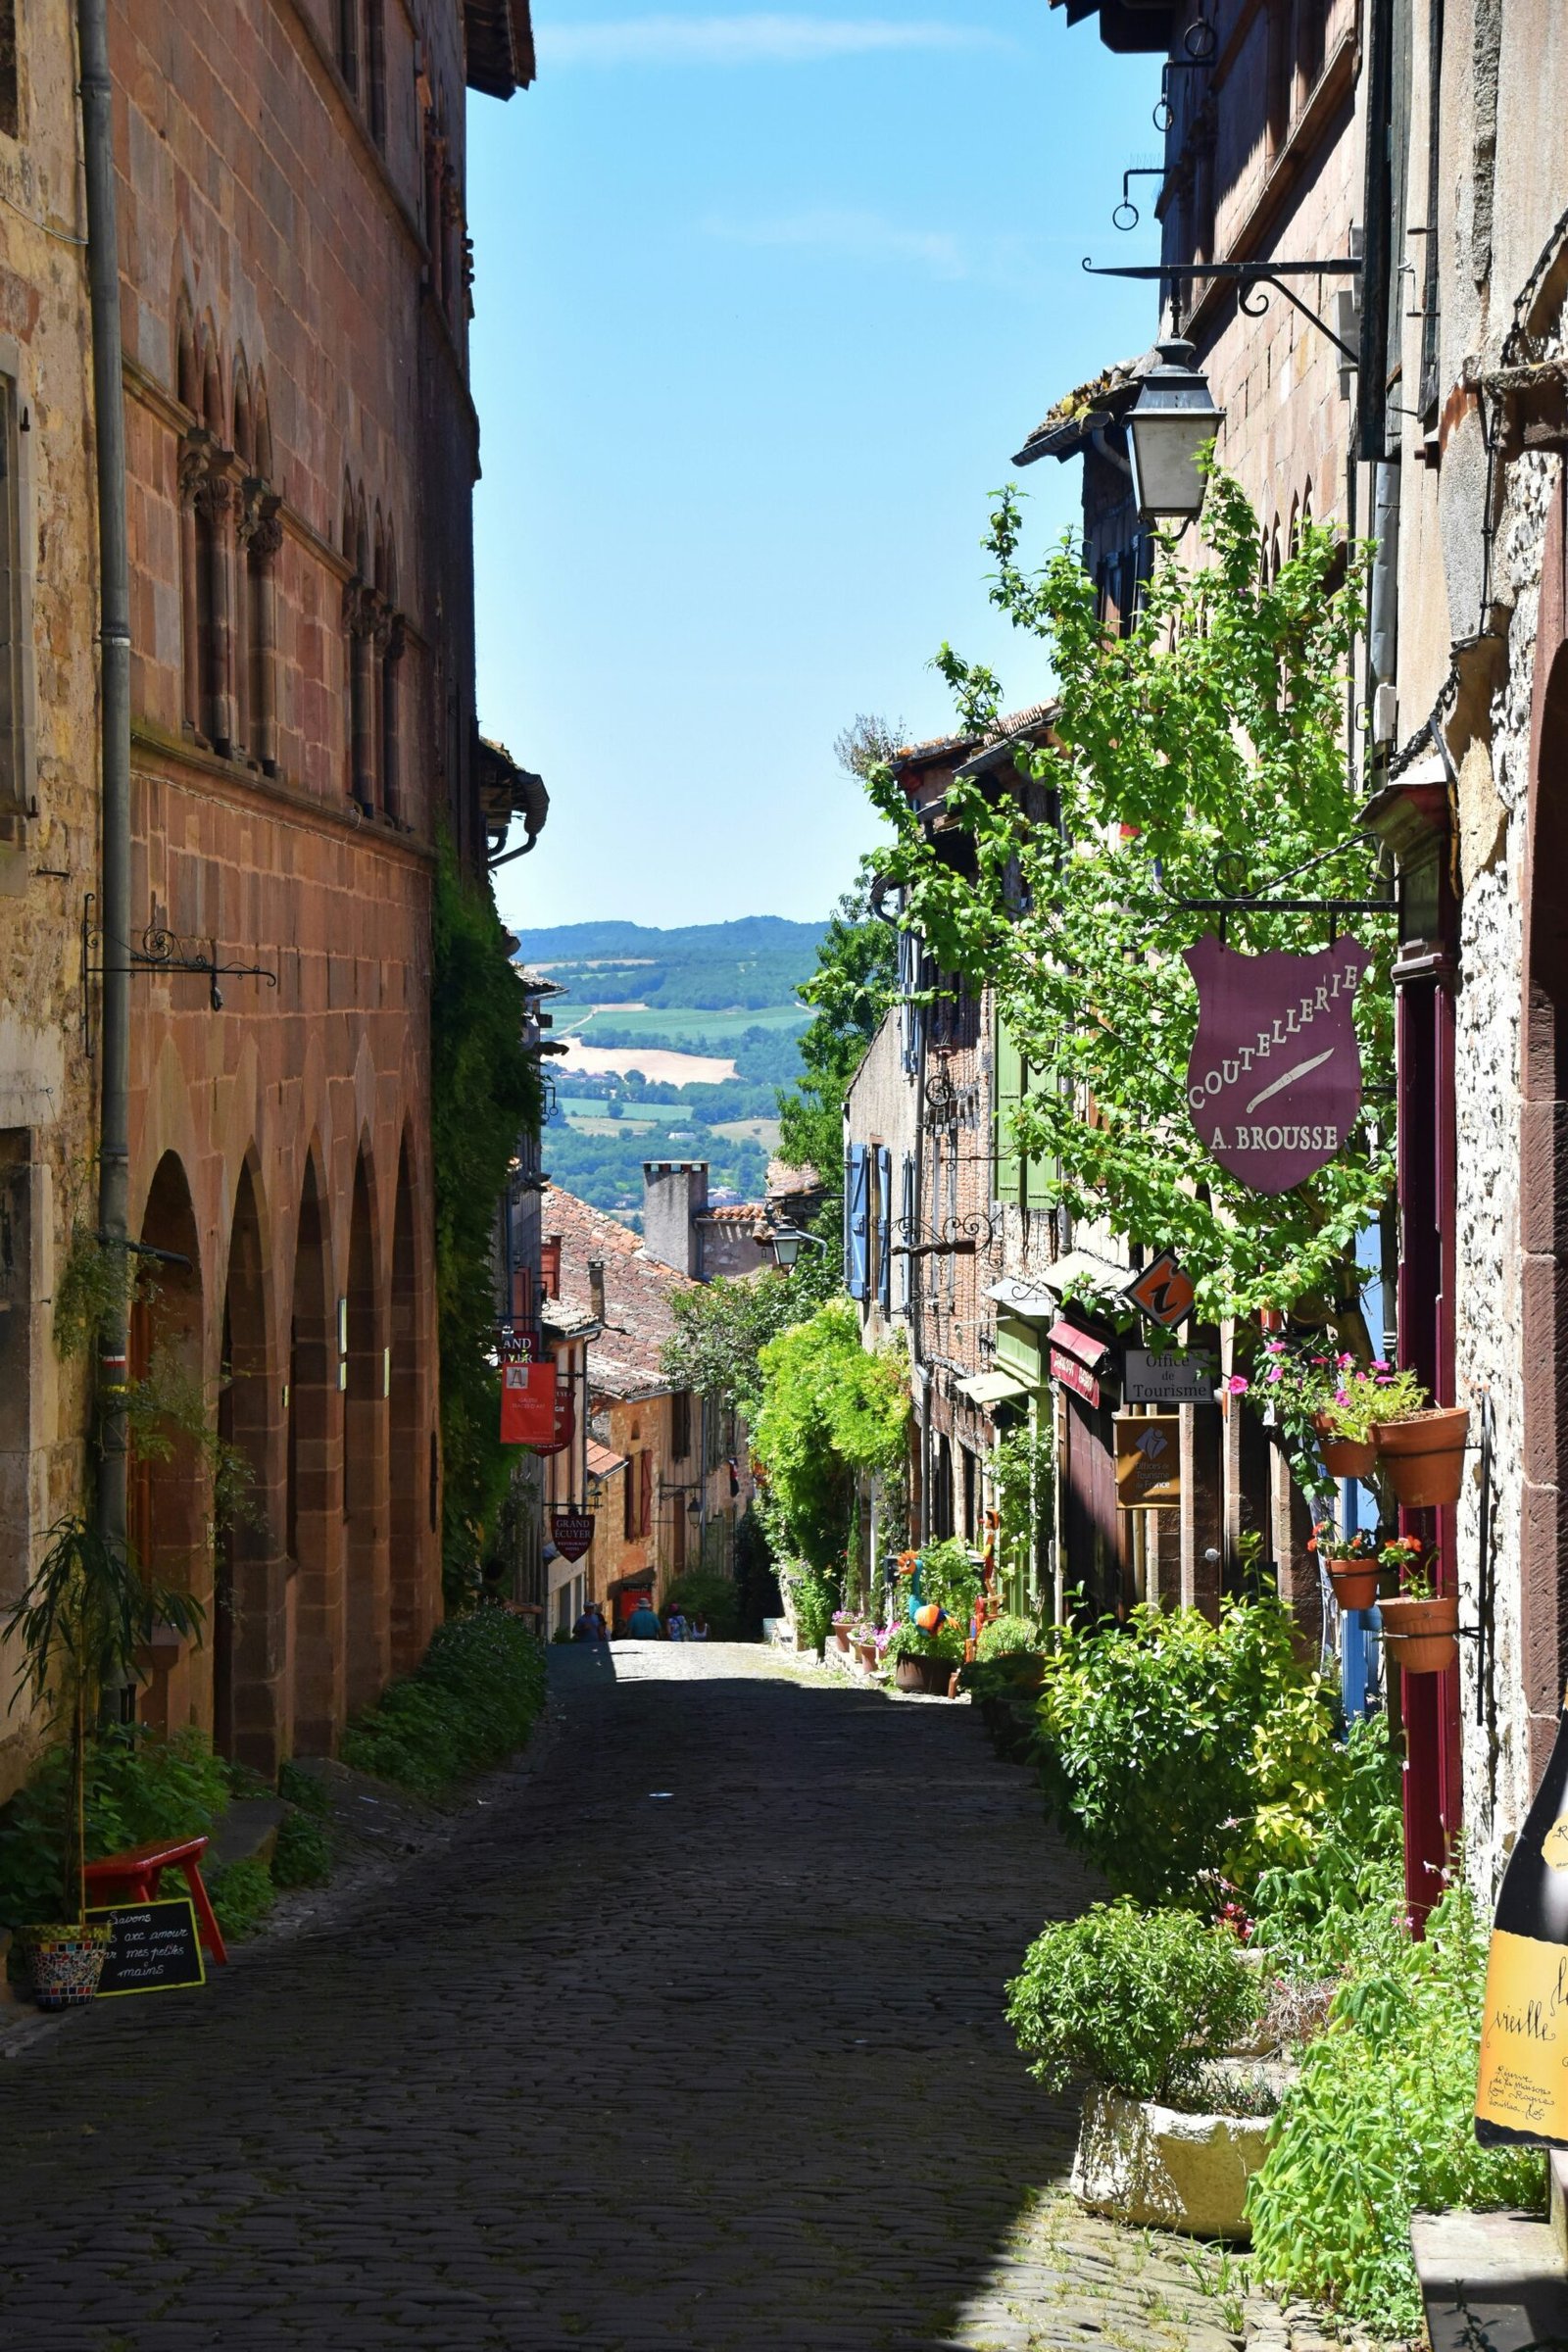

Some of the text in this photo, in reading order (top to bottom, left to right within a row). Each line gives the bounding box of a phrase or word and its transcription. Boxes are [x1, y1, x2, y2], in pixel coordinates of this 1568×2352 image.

[1189, 965, 1358, 1109] COUTELLERIE
[1210, 1126, 1339, 1152] A. BROUSSE
[1146, 1353, 1190, 1368] Office
[1161, 1370, 1175, 1381] de
[1133, 1384, 1206, 1397] Tourisme
[1145, 1481, 1170, 1490] France
[556, 1519, 590, 1528] GRAND
[108, 1910, 152, 1925] Savons
[148, 1928, 189, 1940] amour
[125, 1948, 150, 1958] mes
[150, 1943, 185, 1961] petites
[118, 1961, 165, 1978] mains
